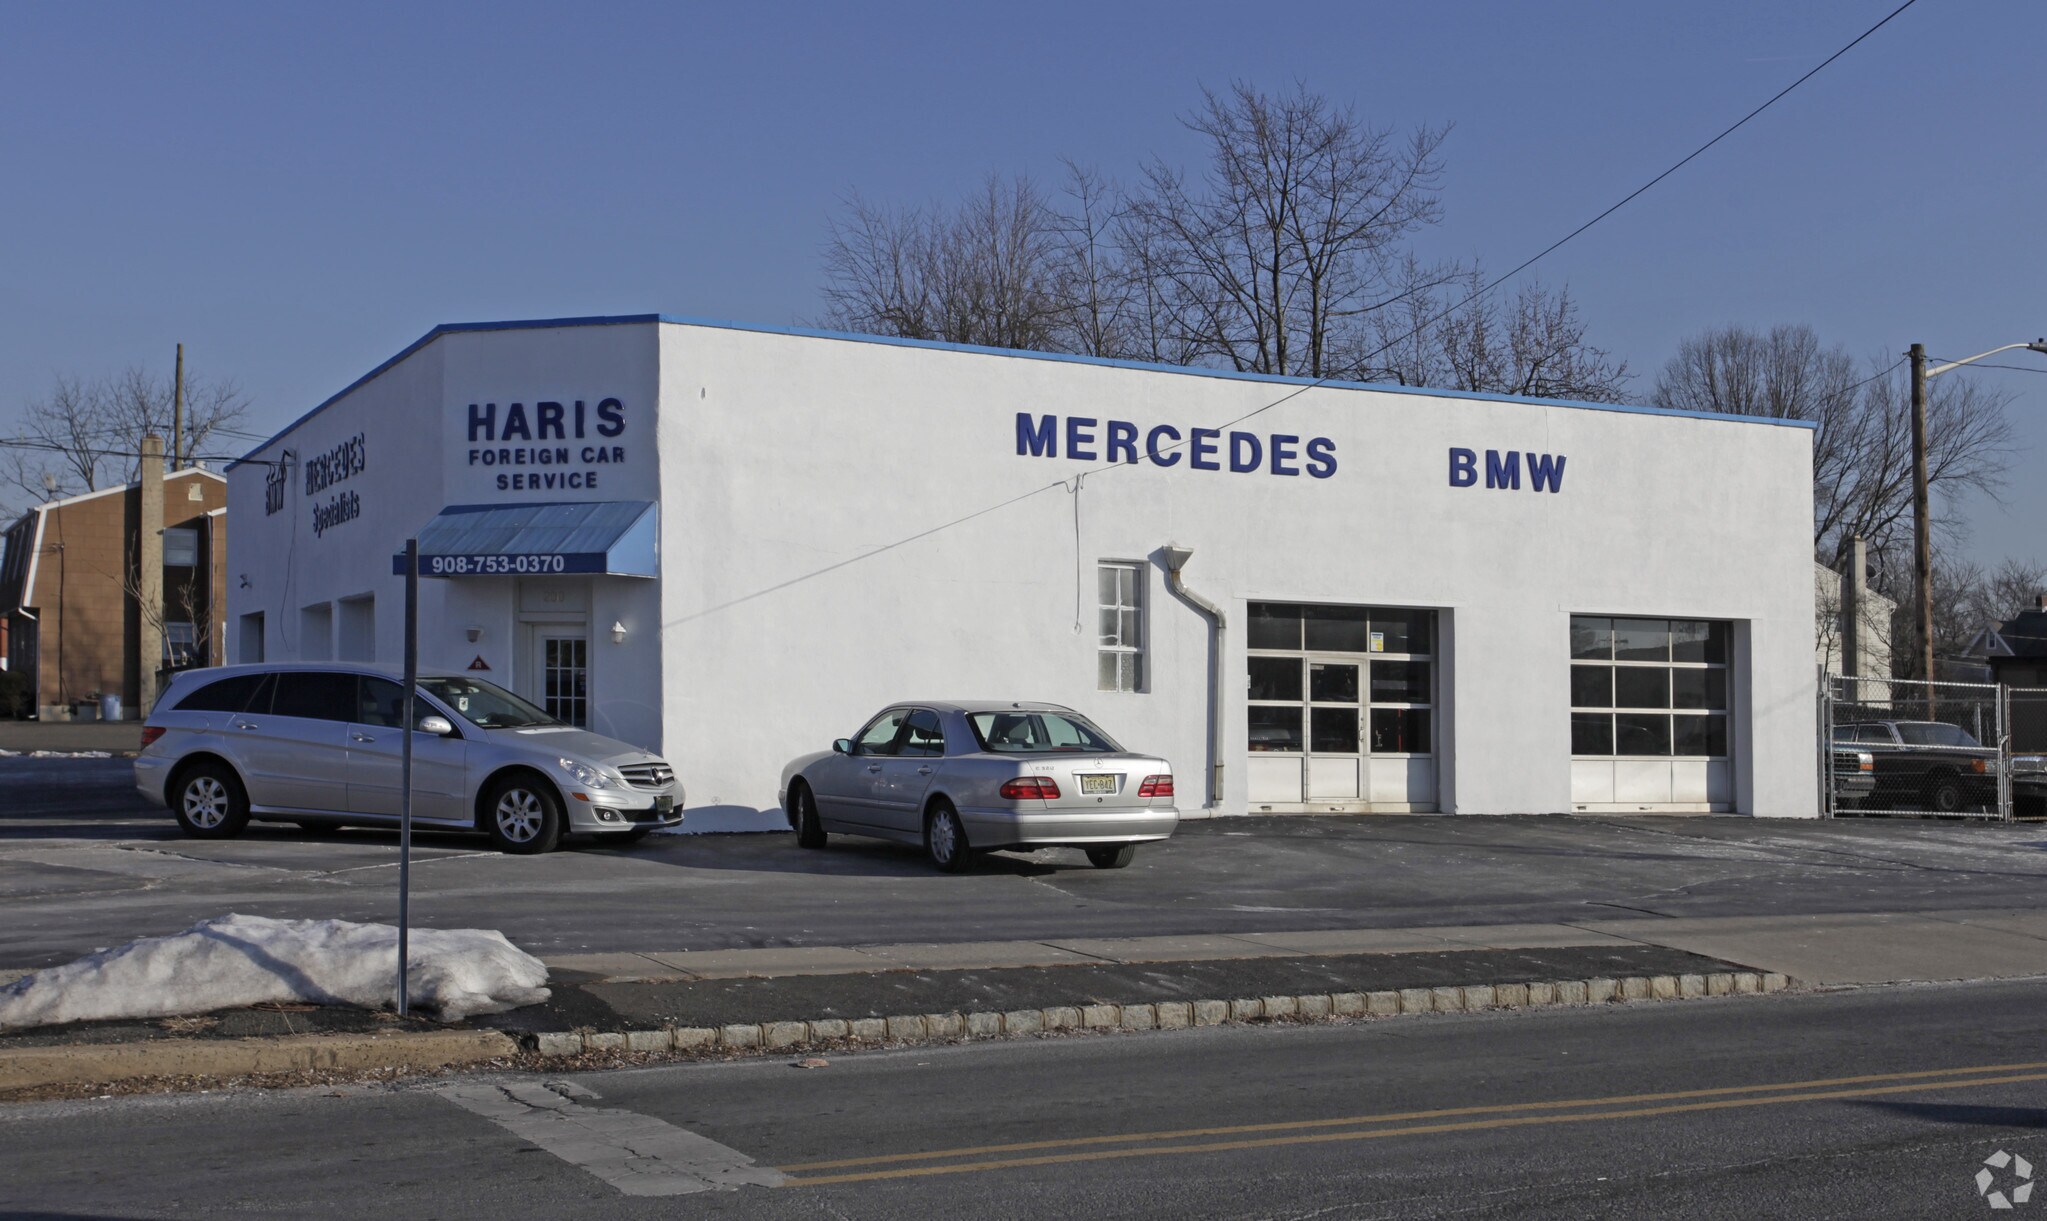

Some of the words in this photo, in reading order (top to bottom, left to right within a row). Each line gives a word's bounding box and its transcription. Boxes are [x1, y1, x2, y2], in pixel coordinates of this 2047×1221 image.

[468, 397, 626, 441] HARIS
[305, 432, 365, 496] MERCEDES
[468, 448, 569, 466] FOREIGN
[581, 446, 625, 464] CAR
[1016, 412, 1338, 479] MERCEDES
[496, 471, 598, 490] SERVICE
[1448, 446, 1567, 494] BMW
[313, 490, 361, 539] Specialists
[432, 555, 565, 573] 908-753-0370
